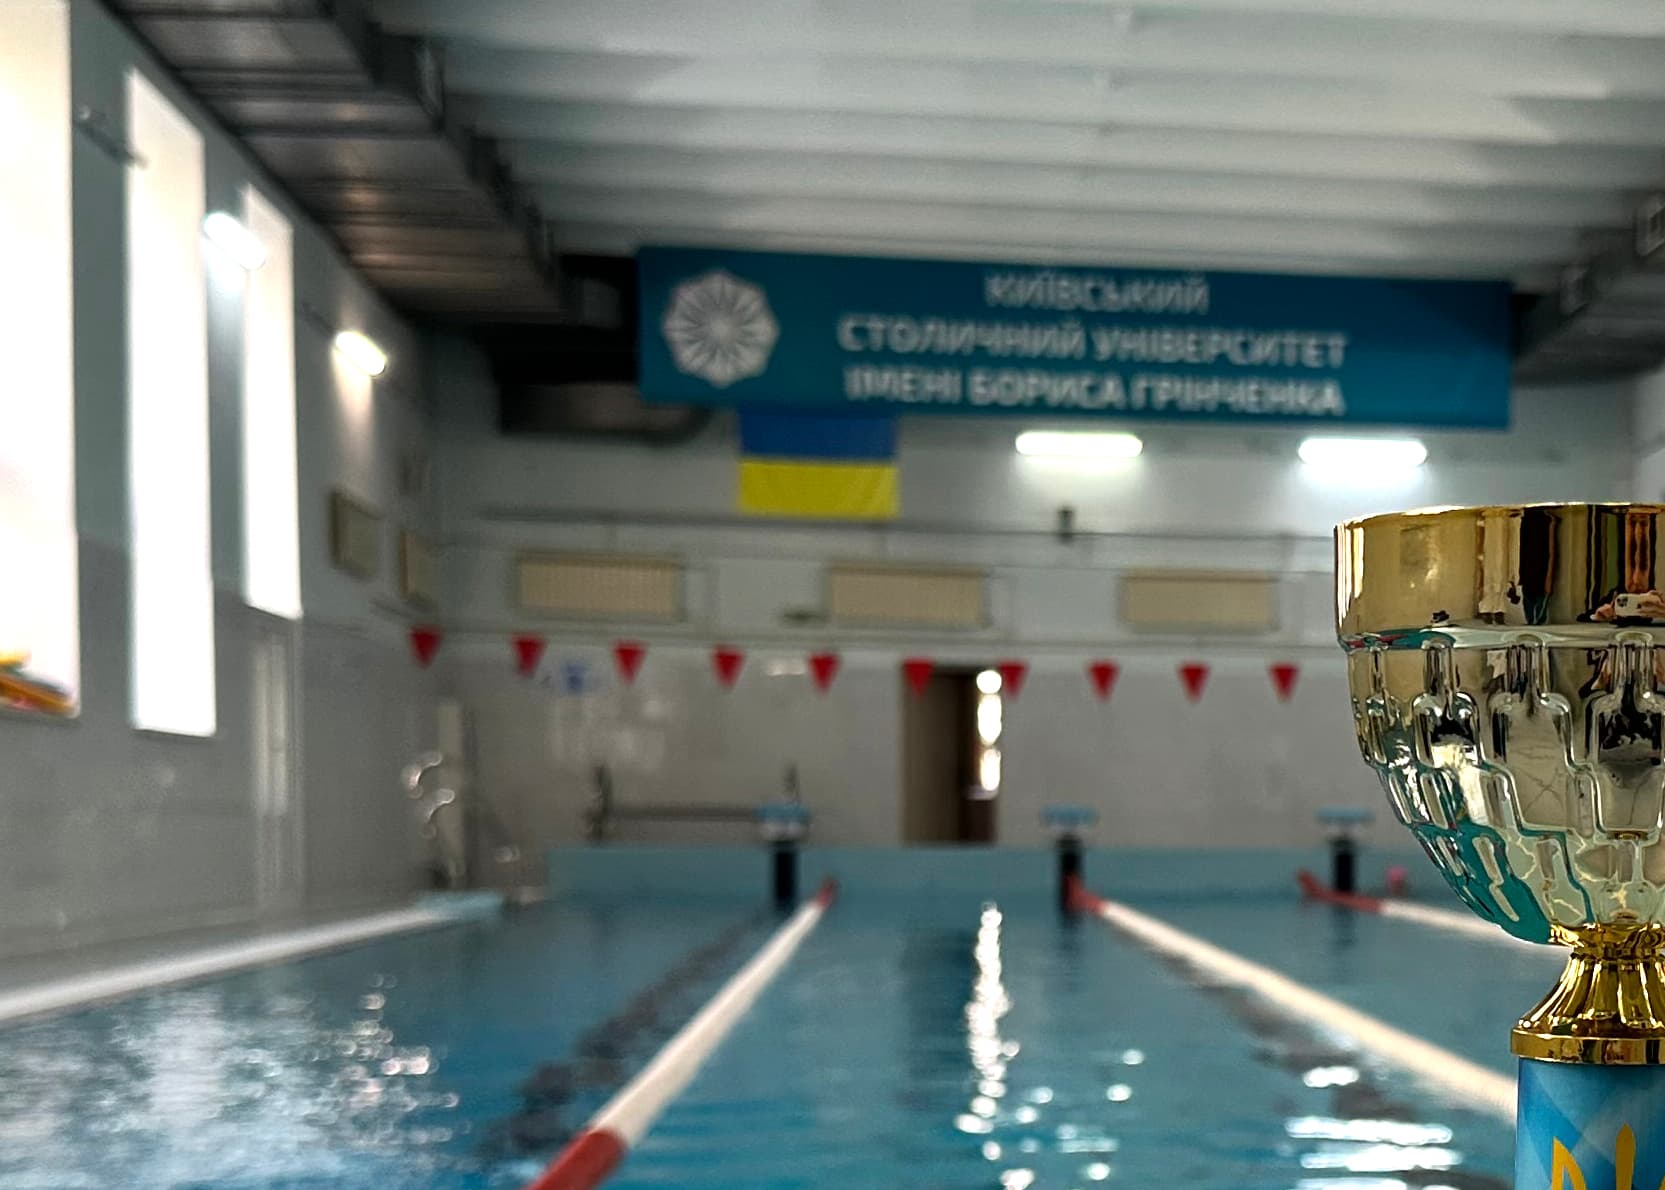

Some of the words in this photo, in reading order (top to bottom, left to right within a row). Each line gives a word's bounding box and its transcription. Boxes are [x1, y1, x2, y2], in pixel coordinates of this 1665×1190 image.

[984, 271, 1208, 314] КИЇВСЬКИЙ
[837, 312, 1087, 360] СТОЛИЧНИЙ
[1091, 324, 1346, 367] УНІВЕРСИТЕТ
[846, 364, 962, 402] ІМЕНІ
[969, 367, 1127, 410] БОРИСА
[1131, 375, 1346, 416] ГРІНЧЕНКА
